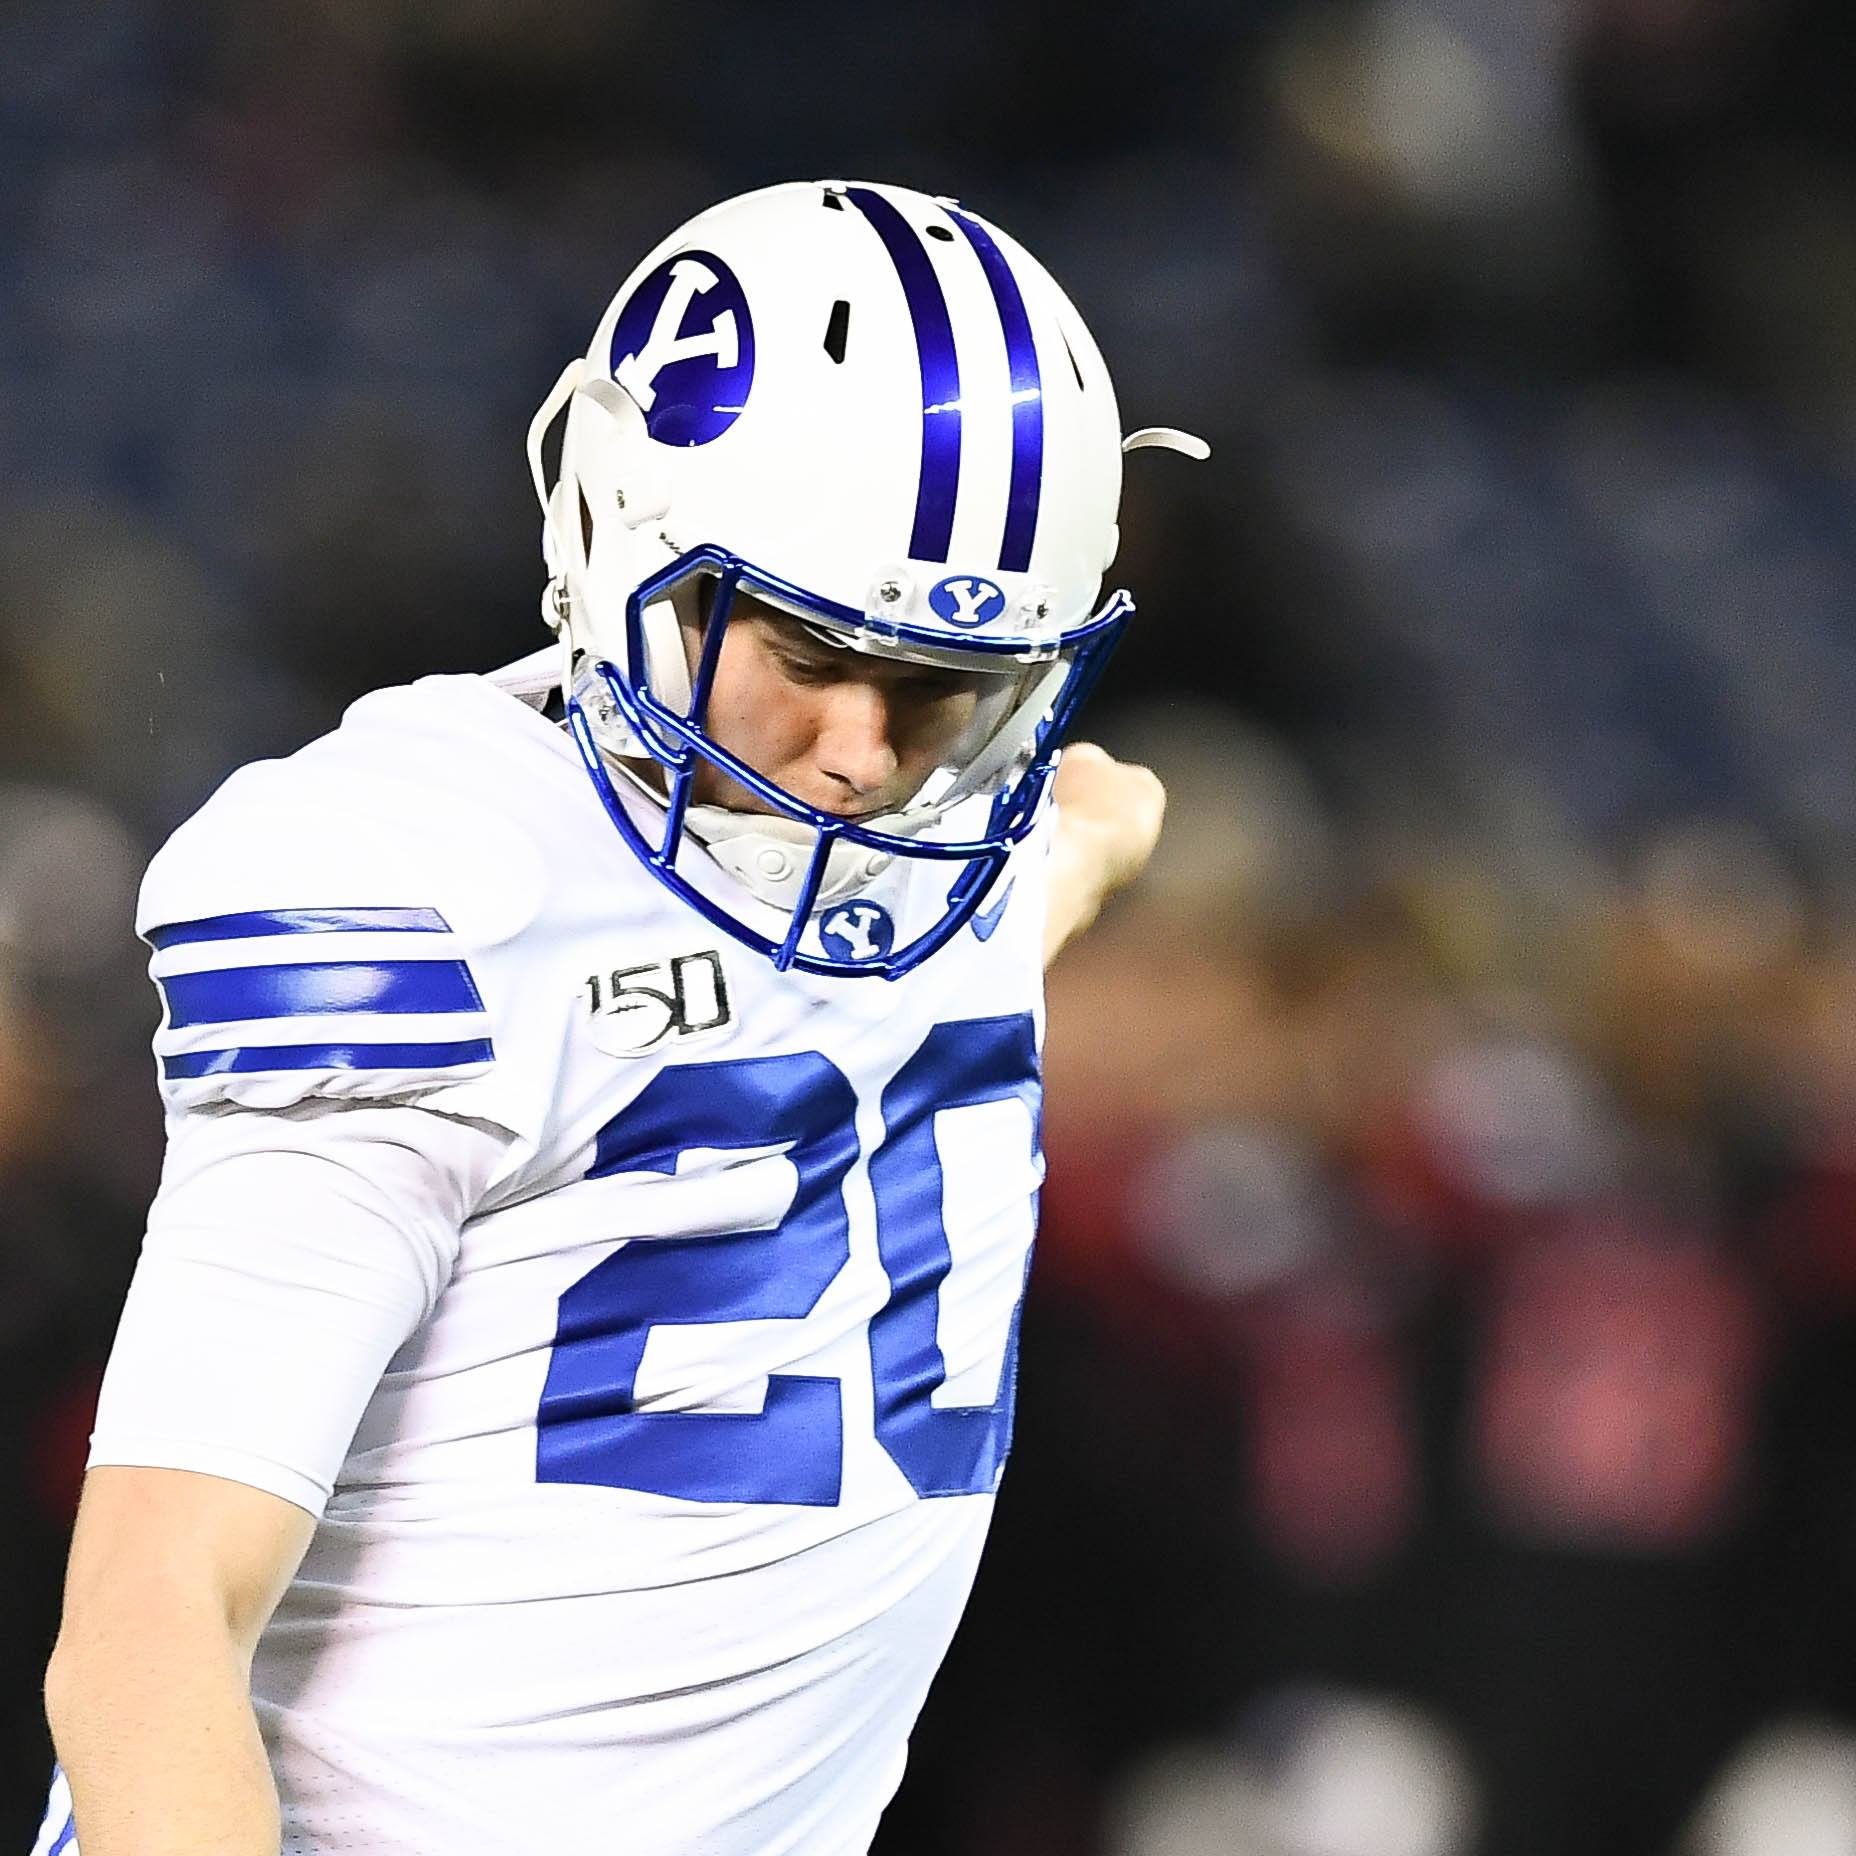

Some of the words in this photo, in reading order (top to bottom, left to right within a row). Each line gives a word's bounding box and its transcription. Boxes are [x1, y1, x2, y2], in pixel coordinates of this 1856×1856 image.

[943, 579, 1000, 623] Y
[823, 906, 882, 960] Y
[584, 949, 731, 1051] 150
[536, 1009, 1044, 1508] 20
